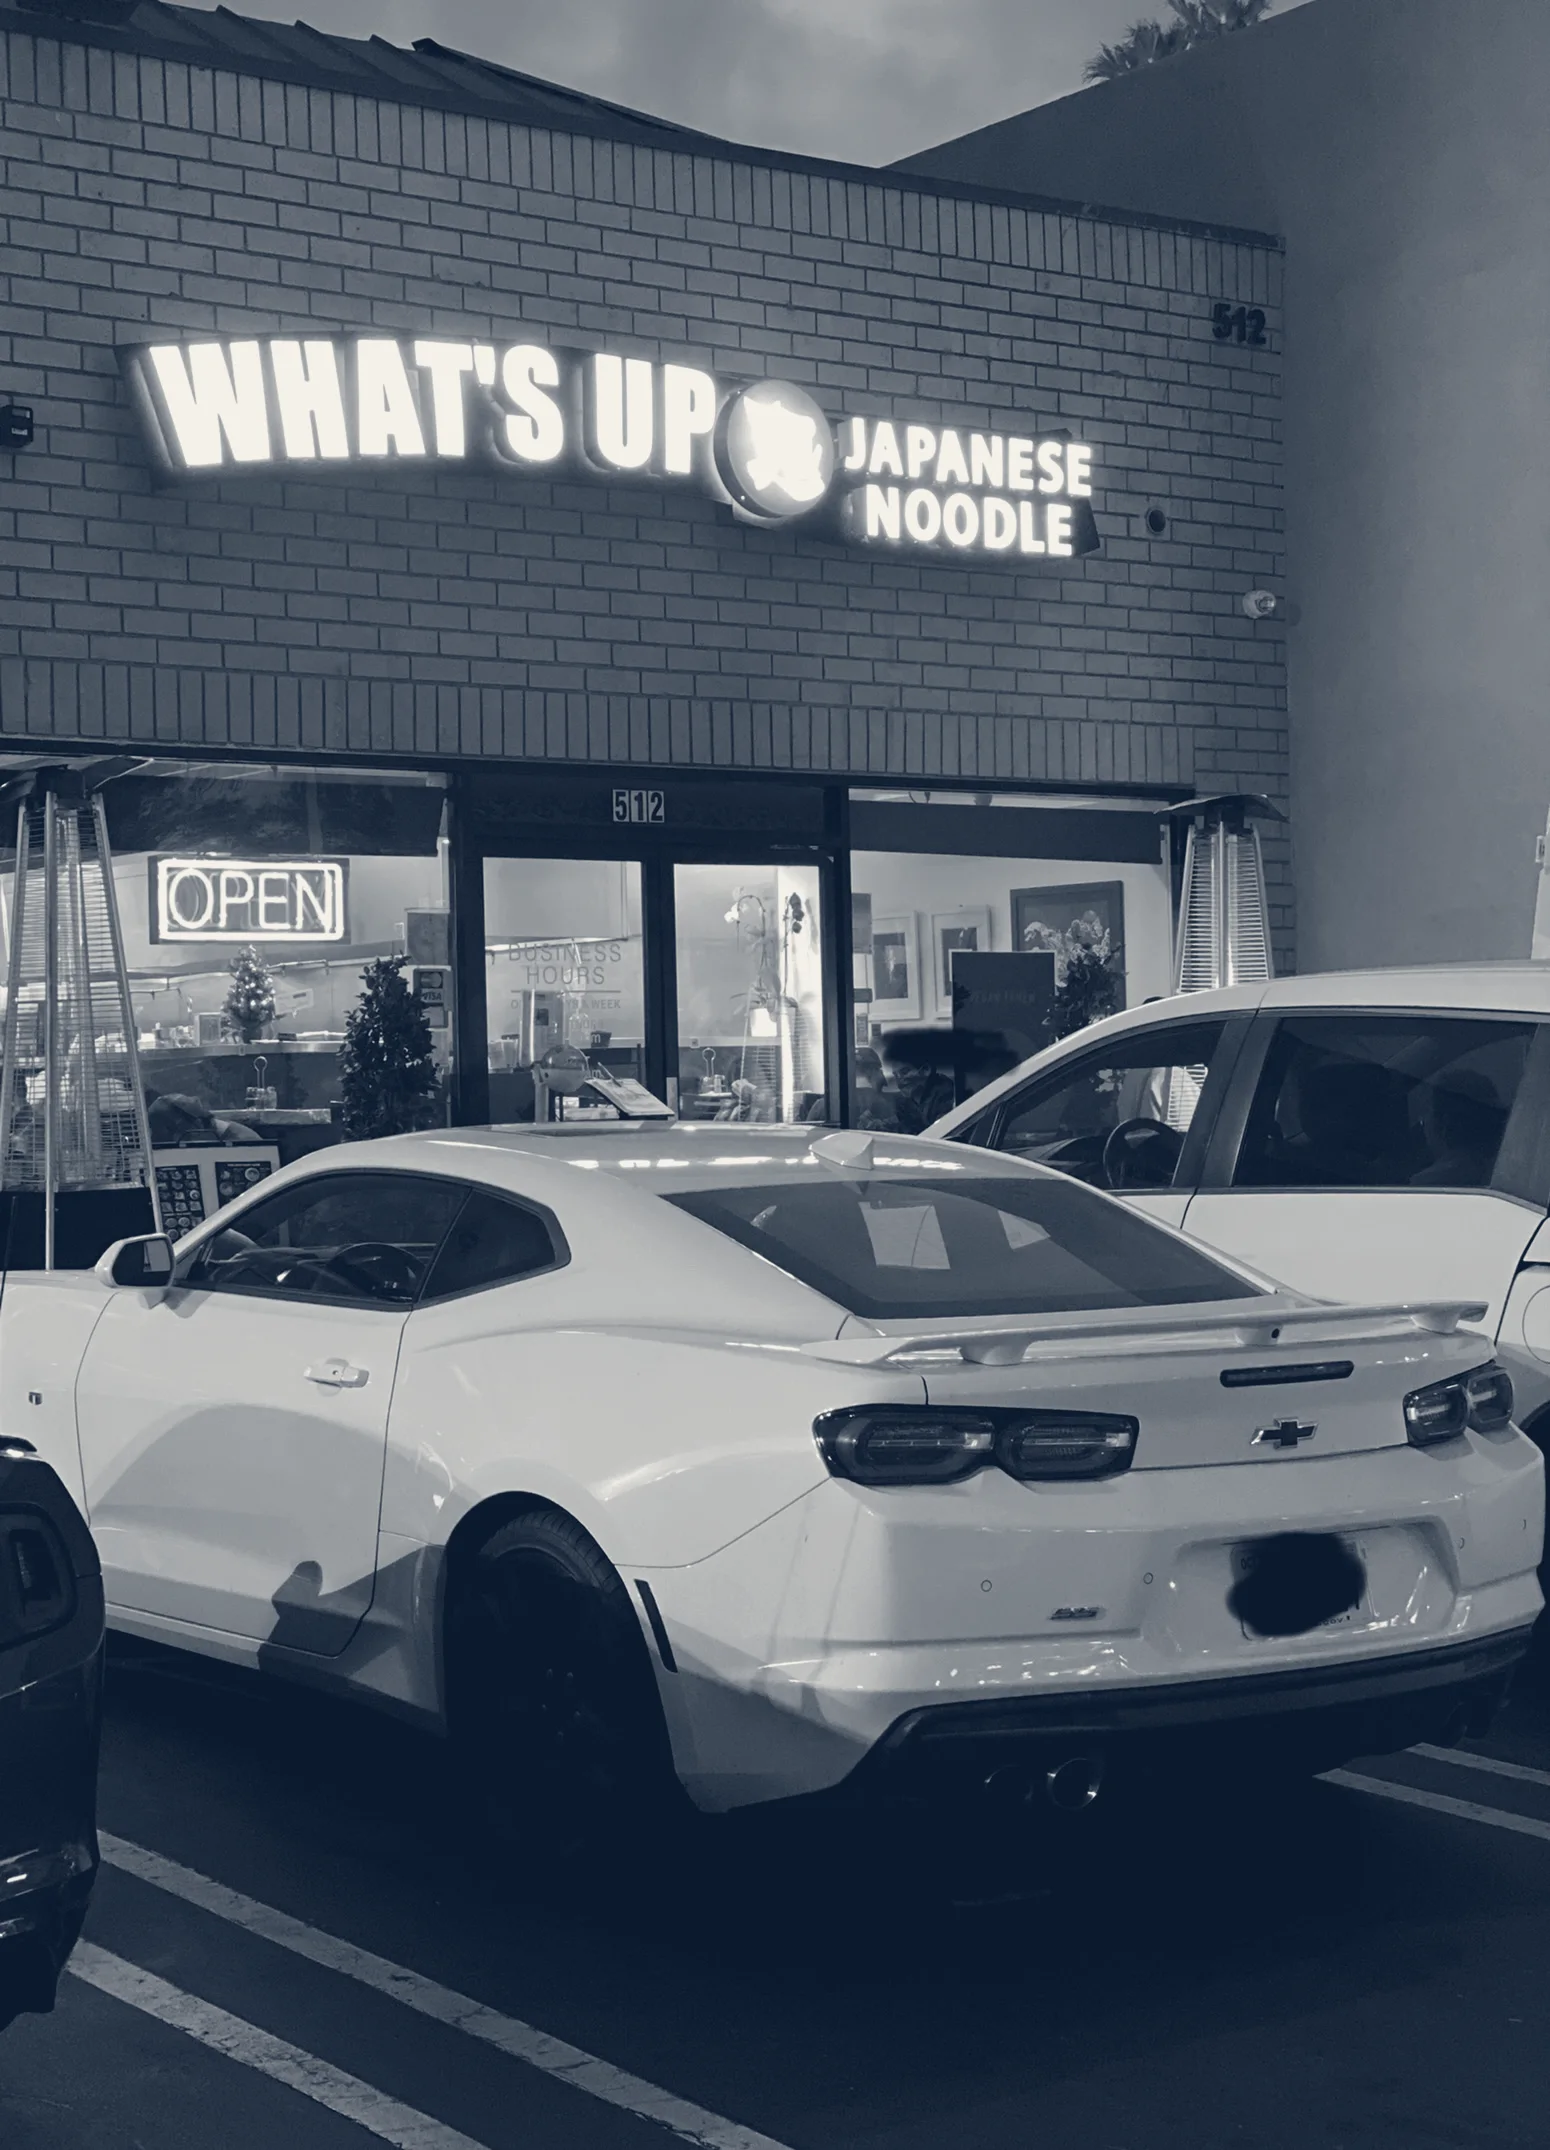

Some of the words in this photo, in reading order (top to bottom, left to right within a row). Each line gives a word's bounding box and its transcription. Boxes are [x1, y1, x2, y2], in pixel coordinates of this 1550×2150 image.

[1212, 303, 1266, 344] 512
[149, 338, 564, 467] WHAT'S
[594, 353, 718, 475] UP
[843, 417, 1092, 497] JAPANESE
[864, 484, 1073, 557] NOODLE
[614, 790, 664, 821] 512
[168, 868, 332, 934] OPEN
[508, 944, 621, 962] BUSINESS
[526, 966, 605, 984] HOURS
